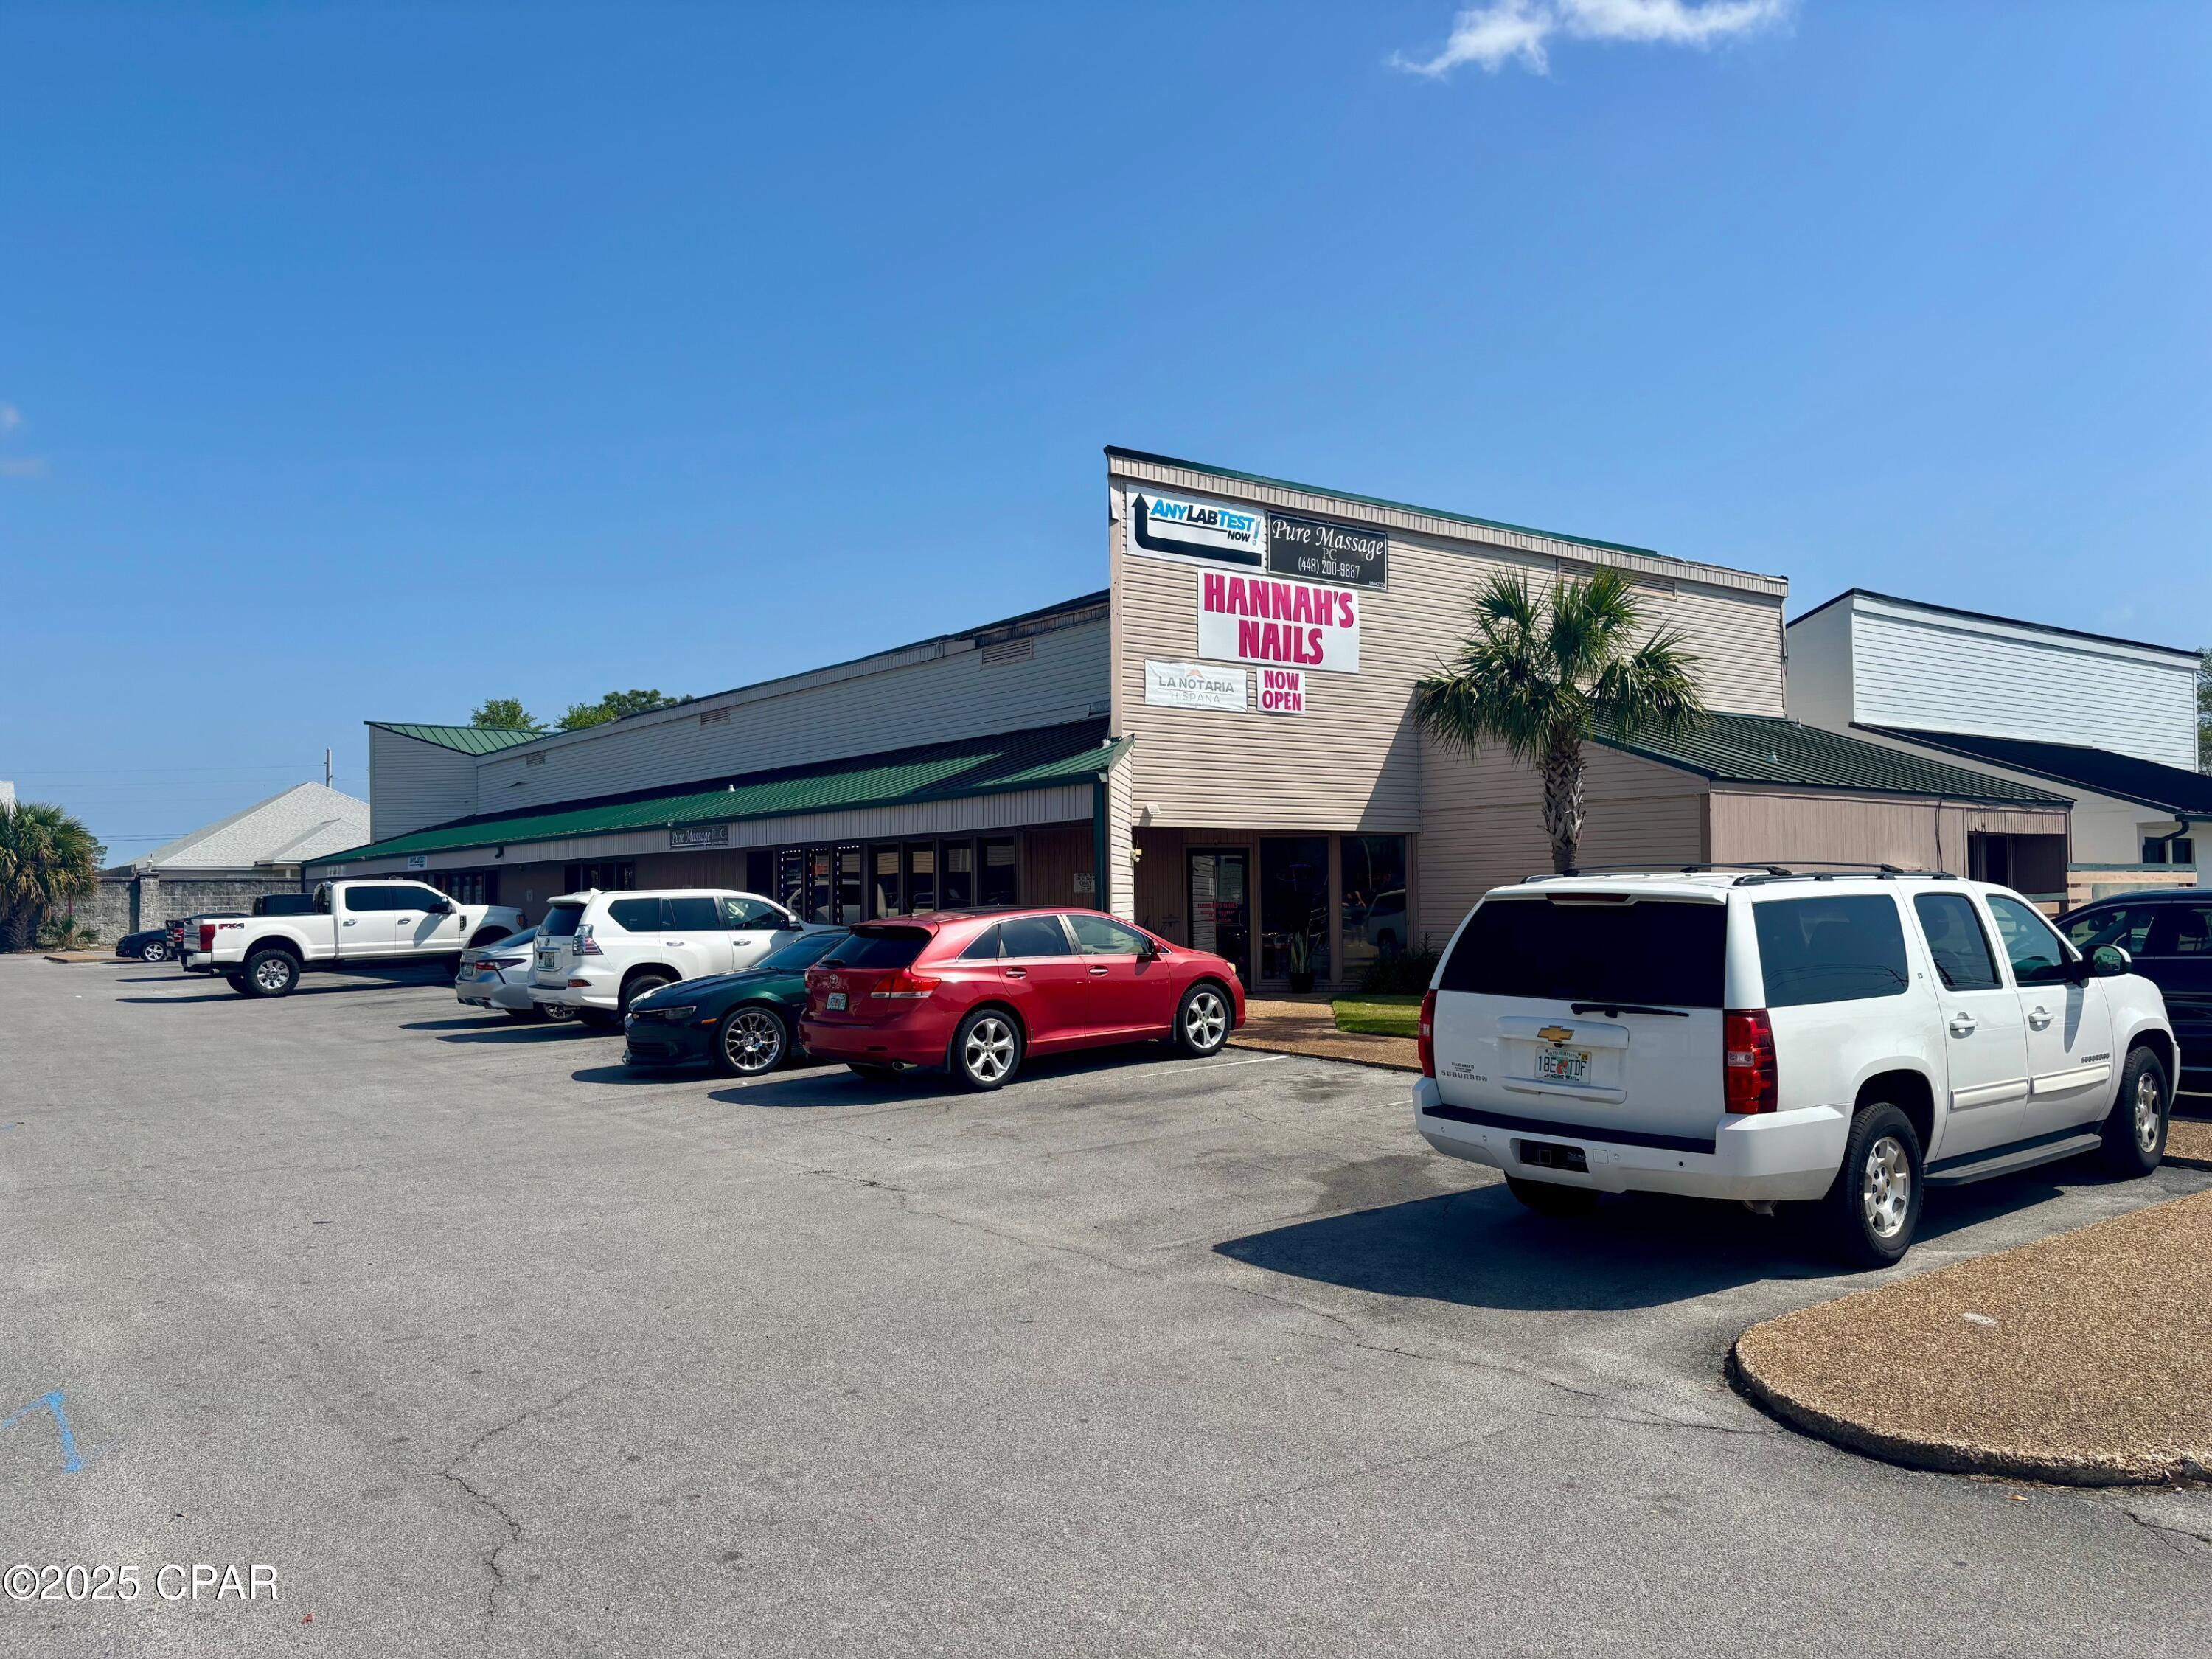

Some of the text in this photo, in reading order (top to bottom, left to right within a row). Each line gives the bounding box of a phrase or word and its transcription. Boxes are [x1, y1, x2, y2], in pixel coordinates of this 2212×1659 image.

[1272, 519, 1383, 561] Pure Massage
[1322, 548, 1337, 561] PC
[1298, 557, 1360, 579] (448) 200-9887
[1203, 572, 1354, 628] HANNAH'S
[1239, 619, 1324, 664] NAILS
[1159, 676, 1234, 693] LA NOTARIA
[1264, 670, 1300, 691] NOW
[1171, 692, 1220, 703] HISPANA
[1262, 690, 1301, 711] OPEN
[672, 831, 685, 844] Pure
[685, 830, 711, 846] Massage
[1441, 1069, 1488, 1082] SUBURBAN
